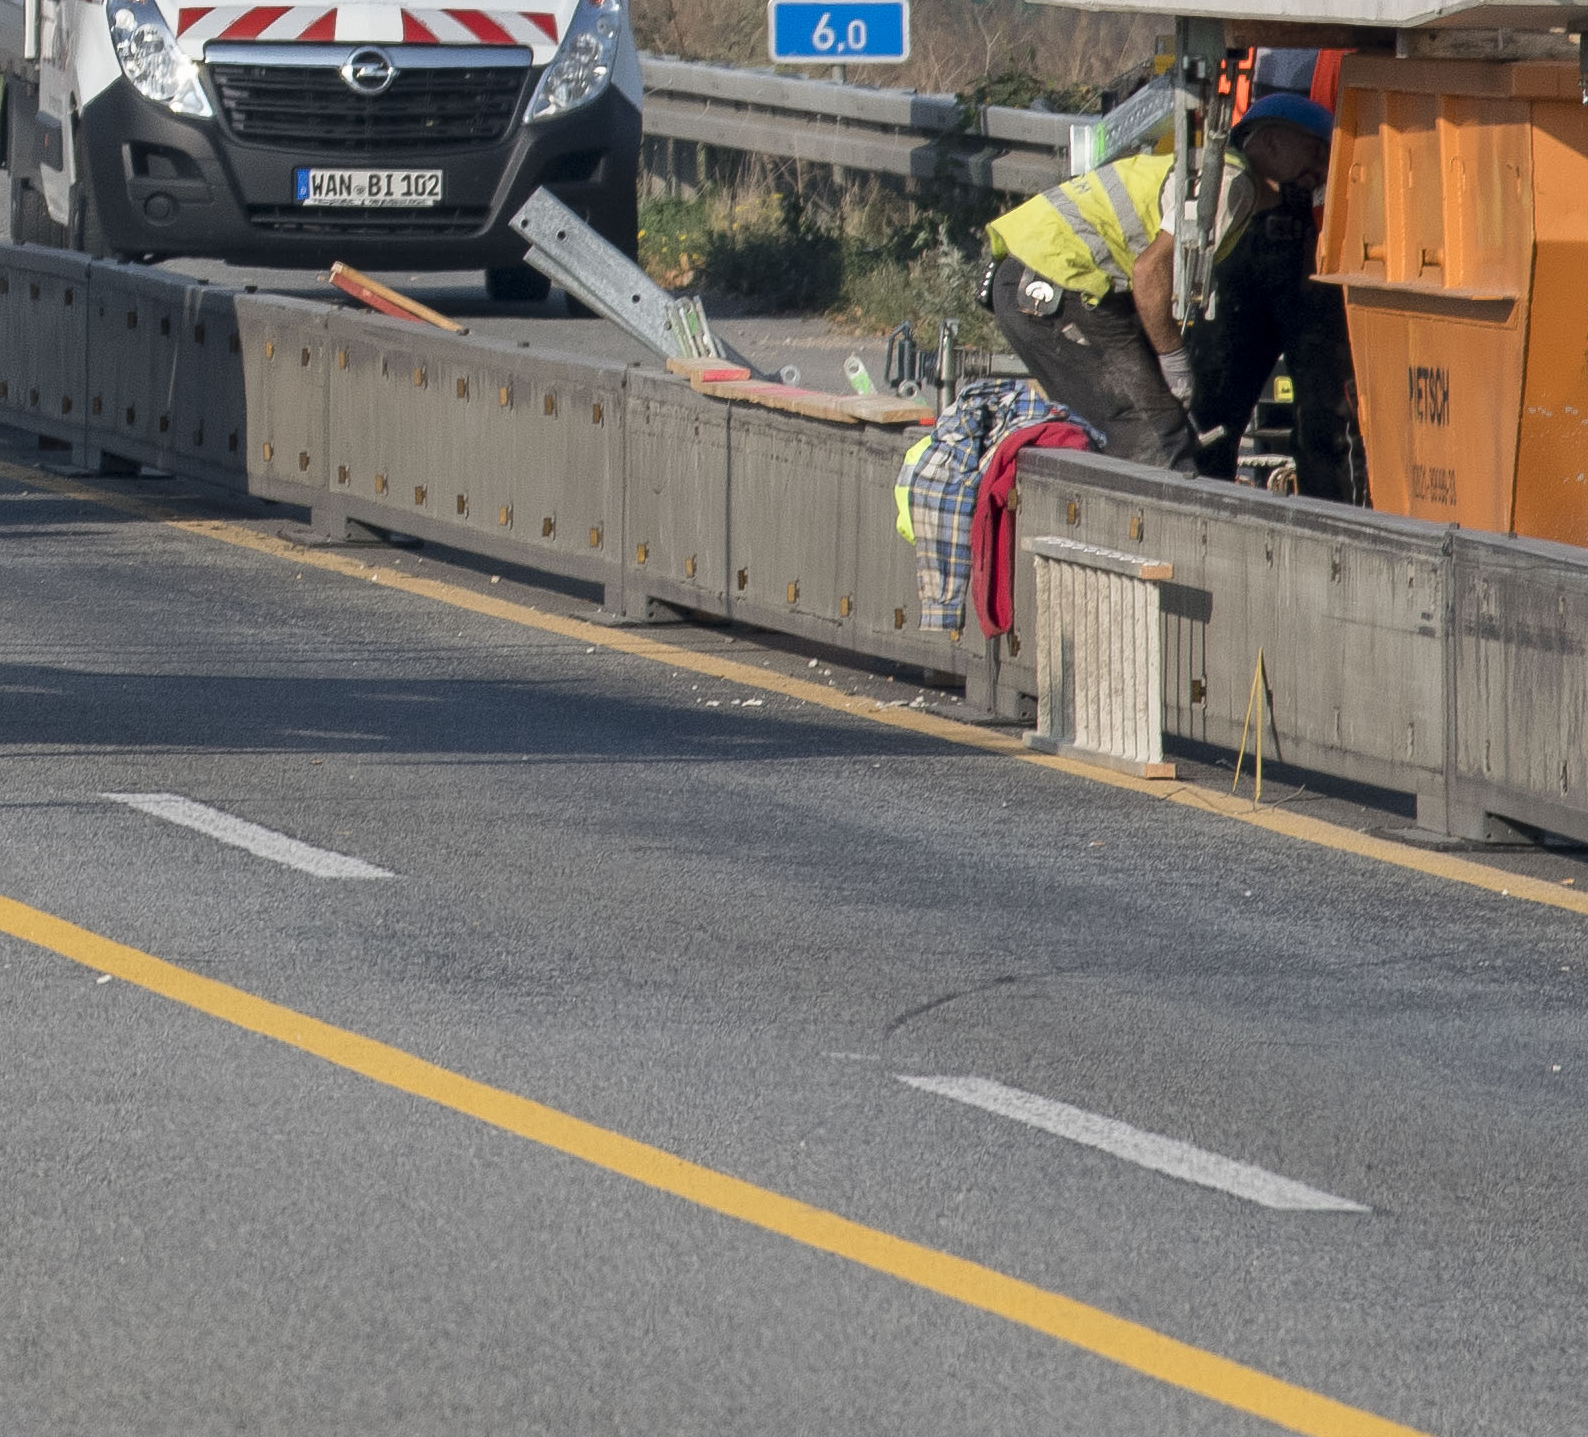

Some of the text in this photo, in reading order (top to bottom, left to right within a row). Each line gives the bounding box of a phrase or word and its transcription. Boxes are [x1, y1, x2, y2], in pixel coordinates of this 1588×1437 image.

[812, 11, 868, 53] 6,0
[311, 173, 440, 197] WAN BI 102
